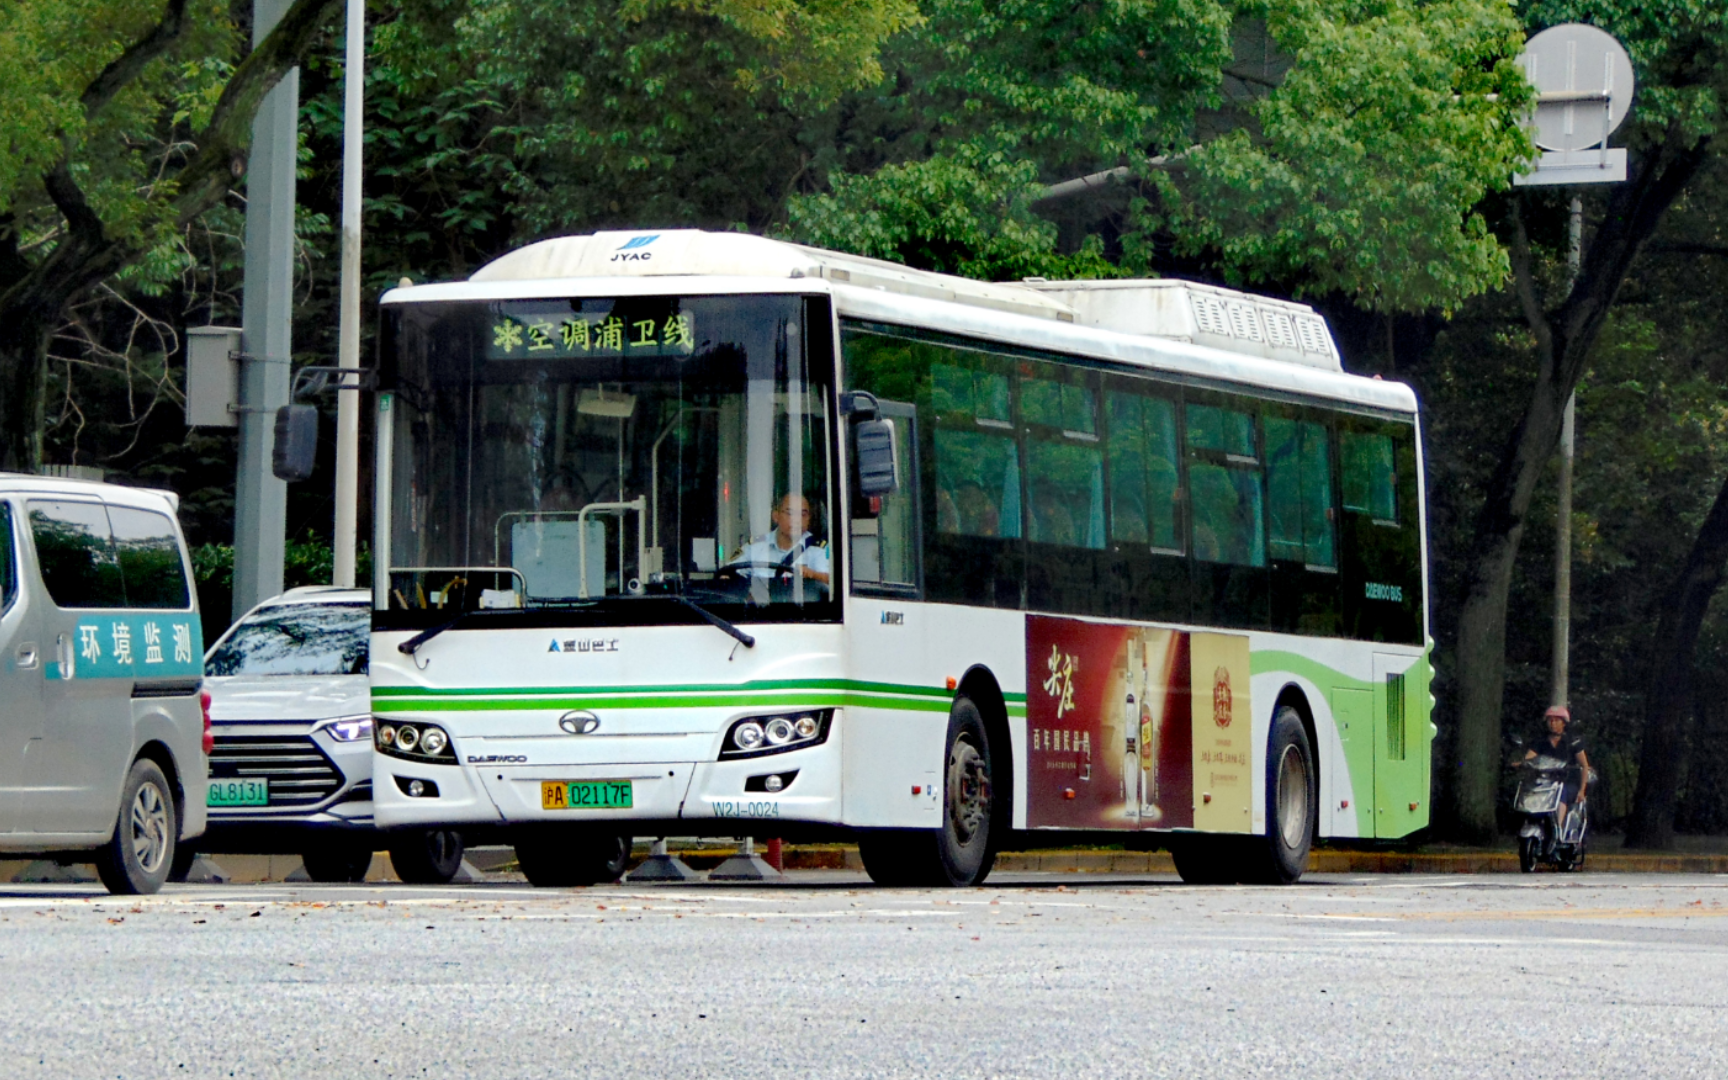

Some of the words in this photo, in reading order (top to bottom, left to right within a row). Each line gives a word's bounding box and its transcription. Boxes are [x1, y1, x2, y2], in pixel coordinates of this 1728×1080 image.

[610, 252, 652, 262] JYAC
[527, 315, 694, 352] 空调浦卫线
[1390, 584, 1402, 602] BUS
[79, 621, 192, 665] 环境监测
[467, 754, 528, 764] DAEWOO
[209, 782, 263, 801] GL8131
[712, 801, 779, 818] W2J-0024
